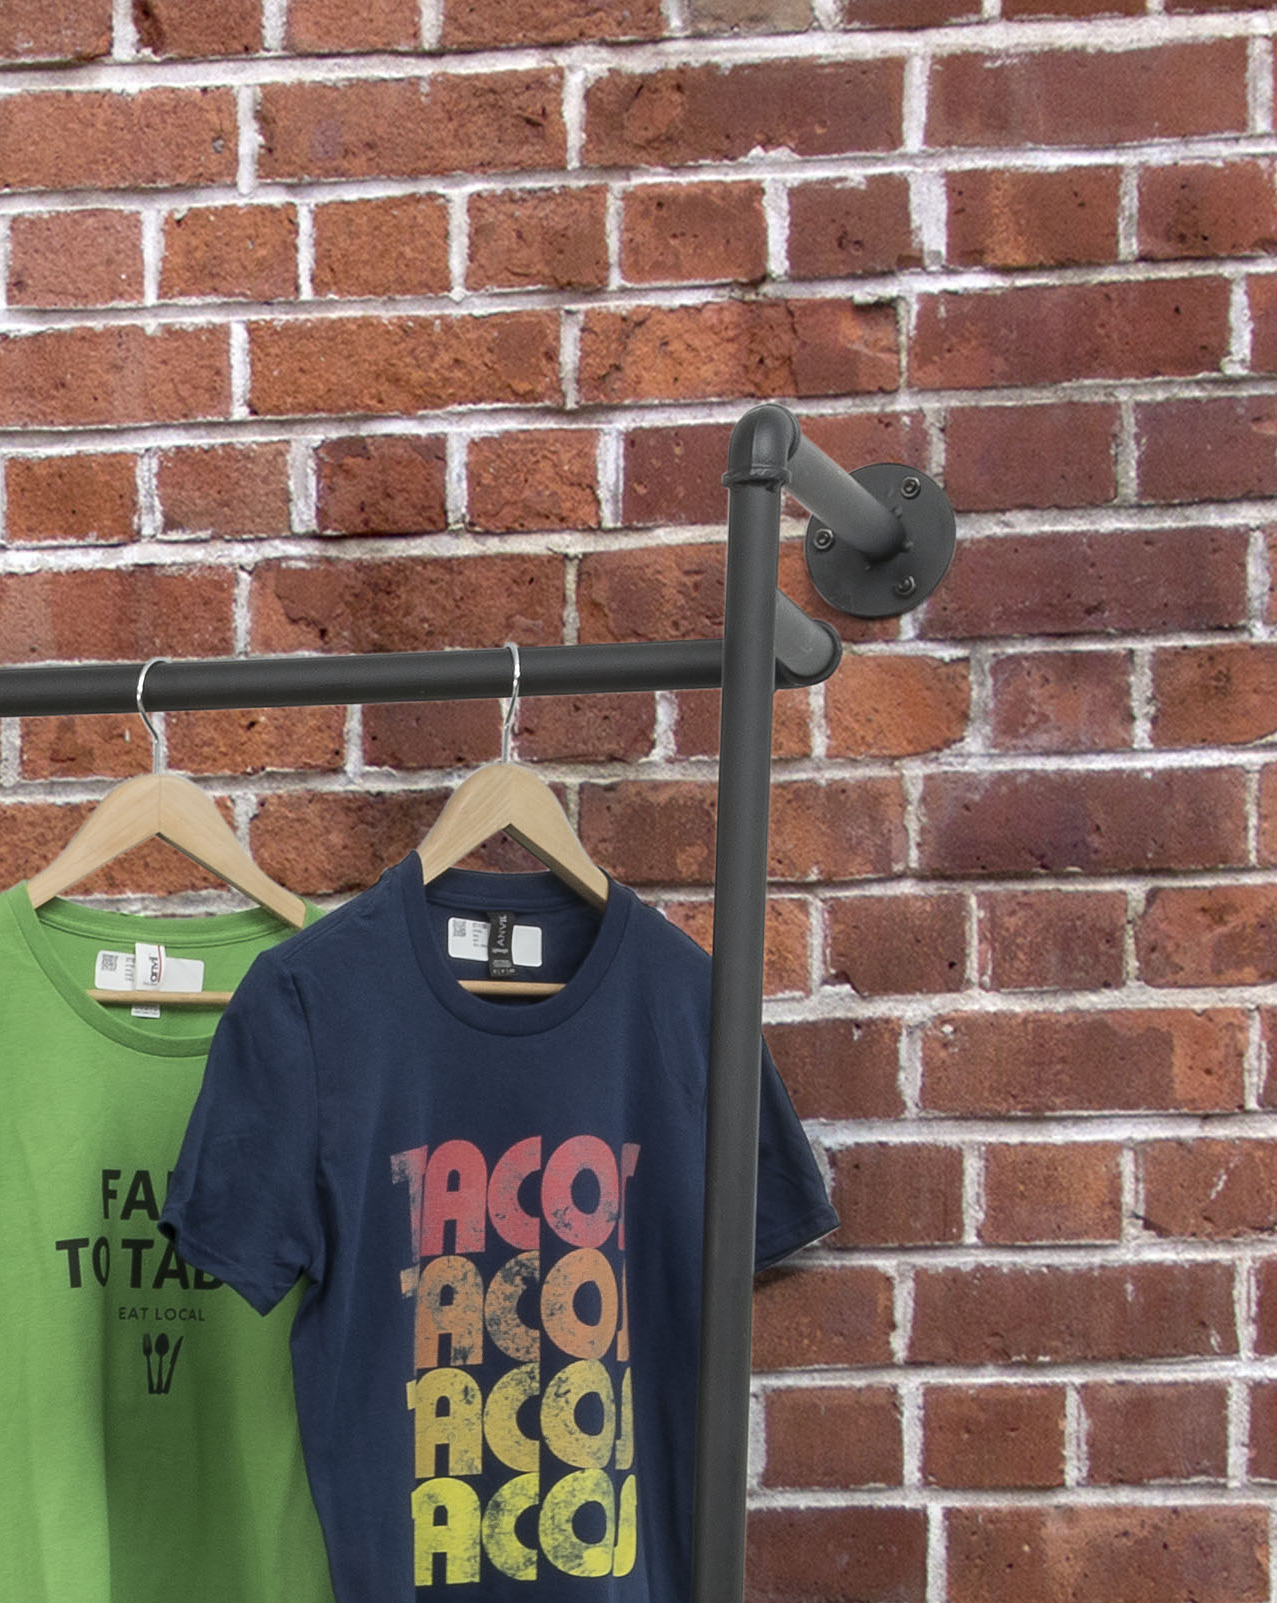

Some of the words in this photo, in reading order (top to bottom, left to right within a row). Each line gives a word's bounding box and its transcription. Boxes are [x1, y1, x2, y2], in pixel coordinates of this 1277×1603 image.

[101, 1169, 175, 1221] FA
[55, 1236, 110, 1288] TO
[118, 1306, 149, 1320] EAT
[155, 1307, 206, 1321] LOCAL
[399, 1247, 631, 1370] ACO
[406, 1359, 634, 1479] ACO
[410, 1468, 638, 1587] ACO
